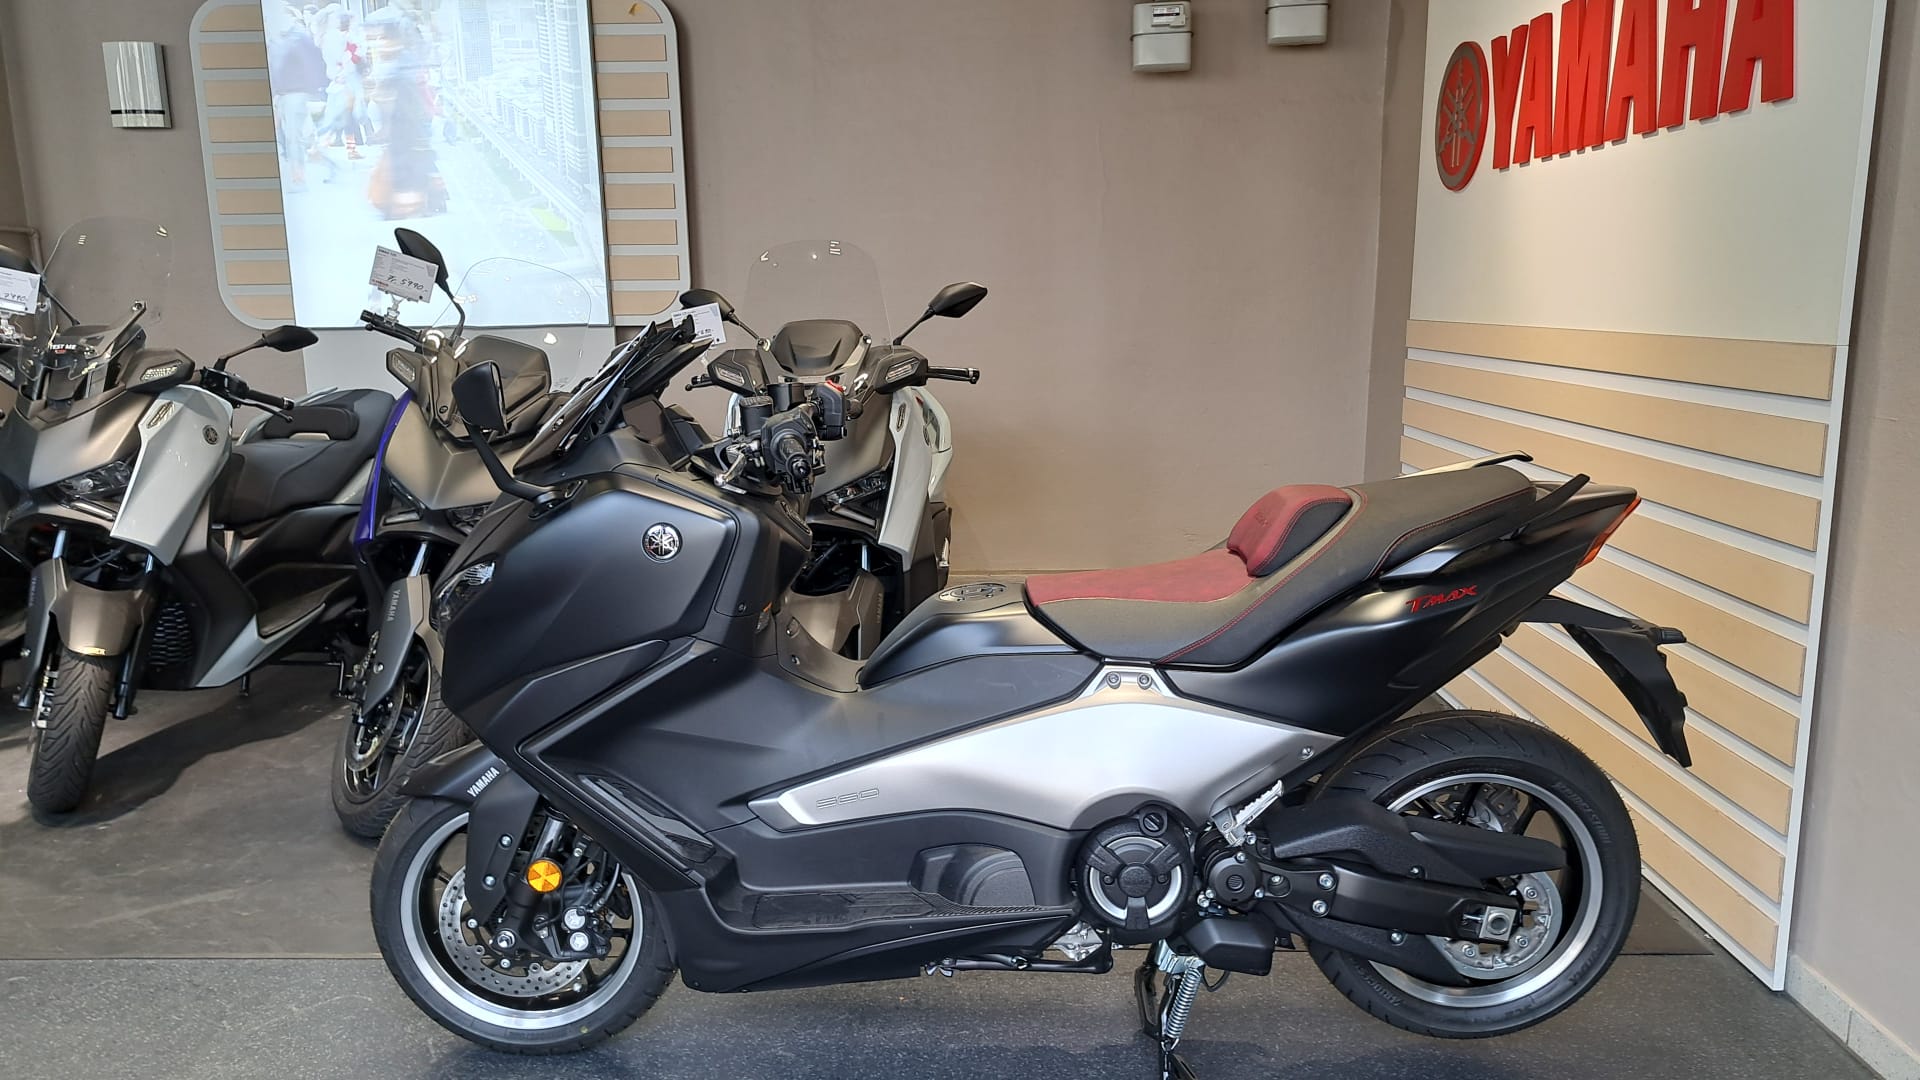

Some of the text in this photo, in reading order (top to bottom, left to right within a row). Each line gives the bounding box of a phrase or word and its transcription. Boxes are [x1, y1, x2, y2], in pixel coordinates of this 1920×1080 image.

[1491, 0, 1794, 169] YAMAHA
[386, 589, 401, 622] YAMAHA
[1405, 584, 1478, 613] TMAX
[467, 766, 500, 797] YAMAHA
[816, 788, 880, 809] 560
